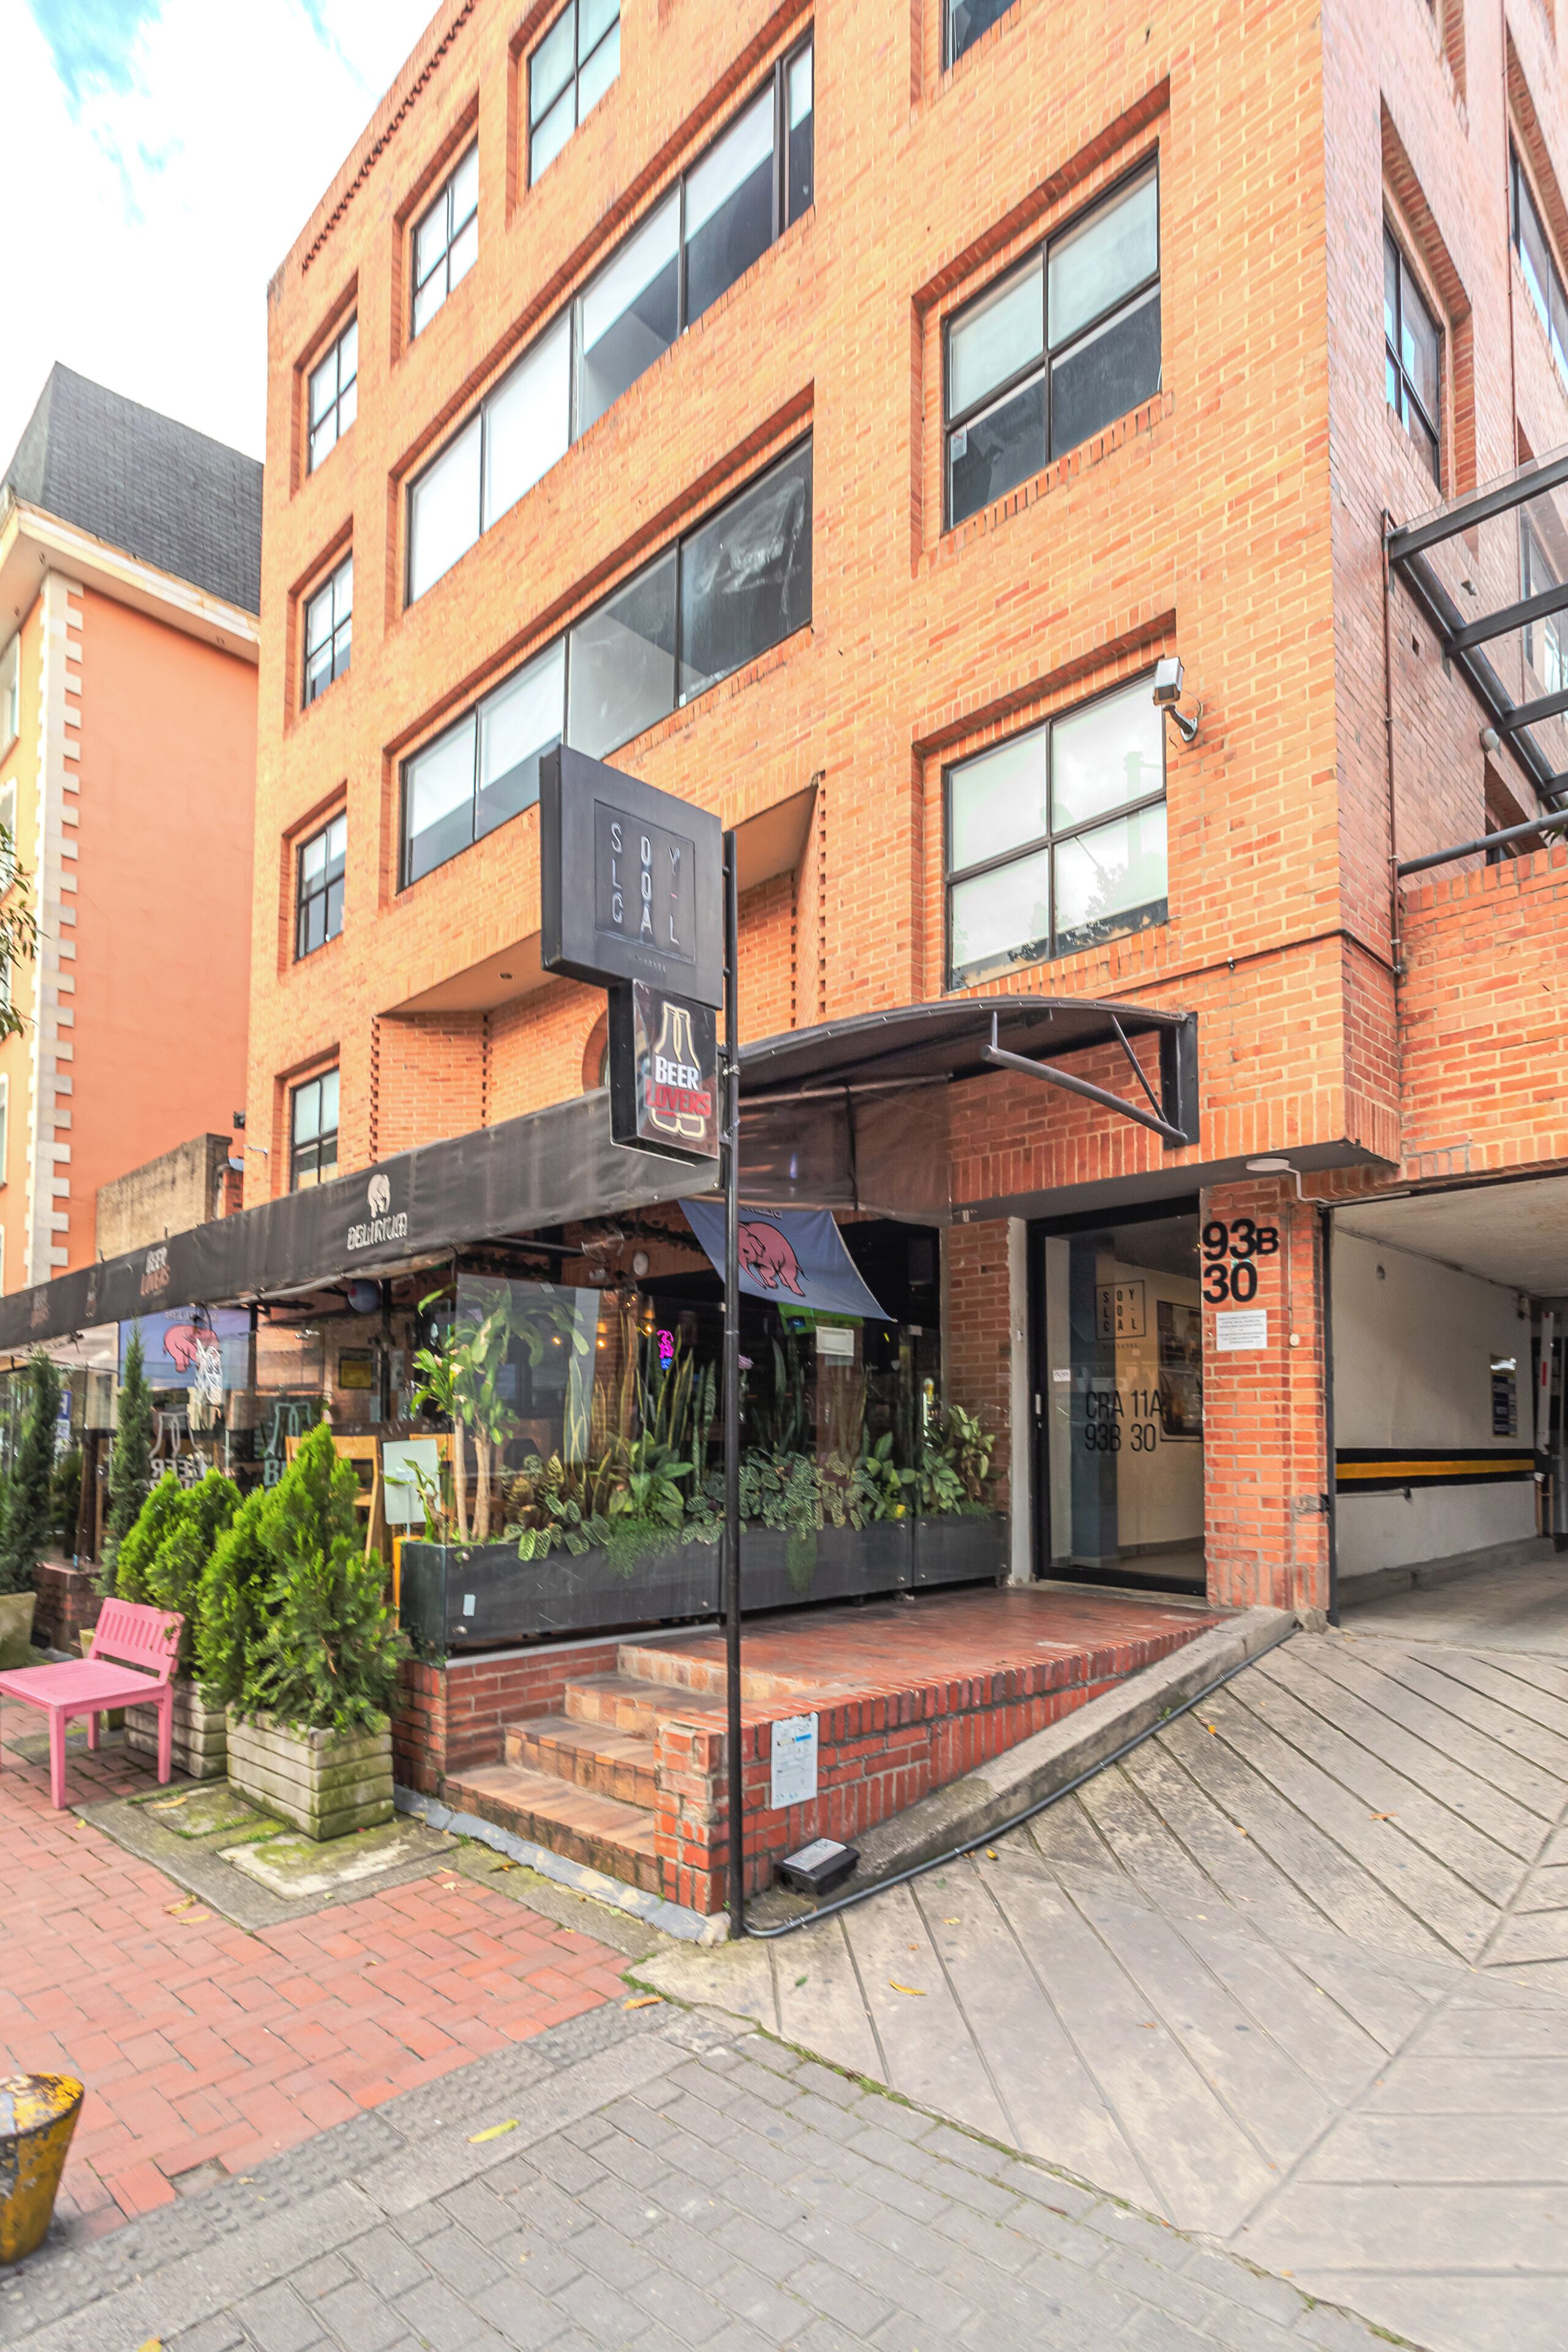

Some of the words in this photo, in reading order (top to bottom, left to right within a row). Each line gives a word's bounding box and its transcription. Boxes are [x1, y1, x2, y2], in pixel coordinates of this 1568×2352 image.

[655, 1055, 699, 1091] BEER
[646, 1078, 712, 1117] LOVERS
[1202, 1218, 1279, 1261] 93B
[1202, 1262, 1257, 1304] 30
[1086, 1390, 1125, 1419] CRA
[1131, 1389, 1164, 1418] 11A
[1085, 1423, 1121, 1452] 93B
[1131, 1423, 1156, 1452] 30
